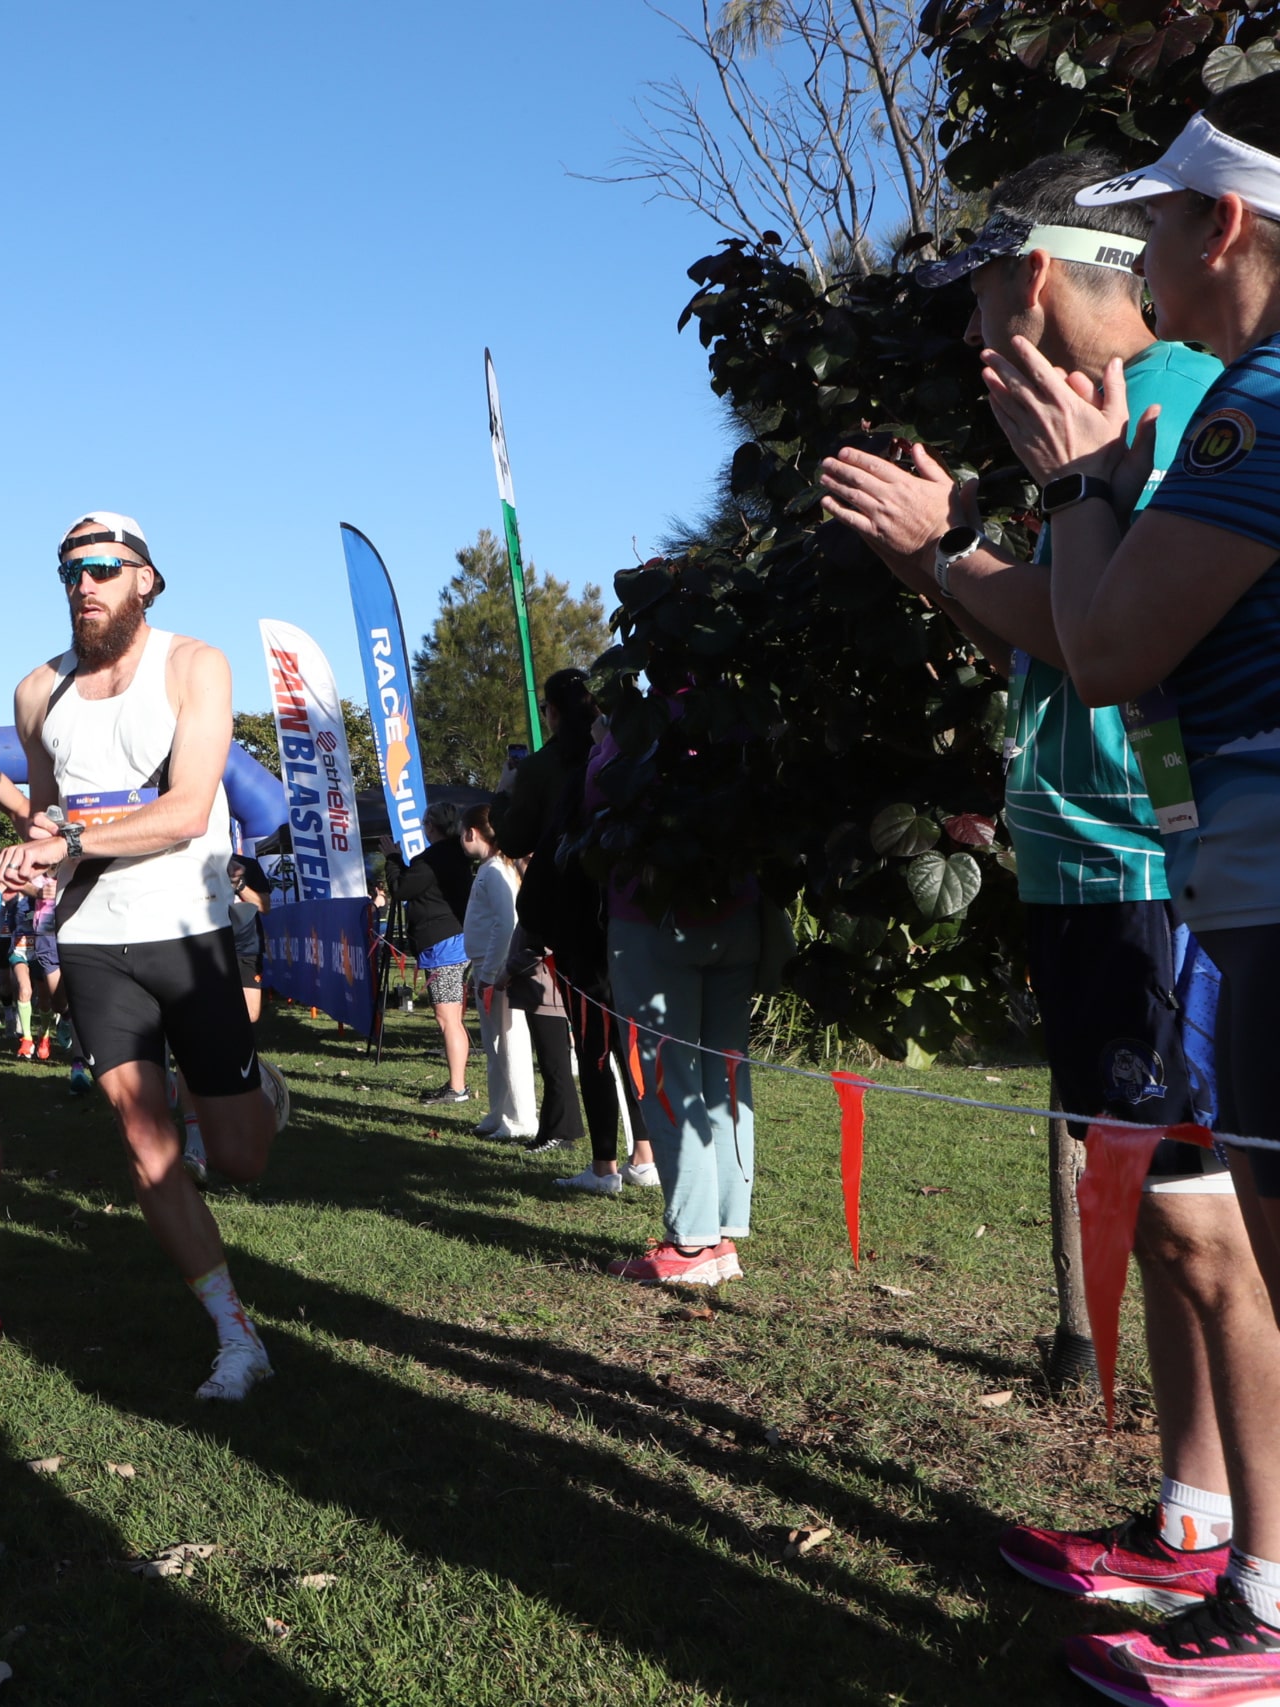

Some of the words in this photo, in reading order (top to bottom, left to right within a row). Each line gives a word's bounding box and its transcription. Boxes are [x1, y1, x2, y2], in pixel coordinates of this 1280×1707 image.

[1095, 246, 1139, 268] IRO
[270, 648, 310, 733] PAIN
[371, 628, 403, 745] RACE
[395, 770, 426, 860] HUB
[1162, 751, 1183, 769] 10k
[282, 735, 332, 900] BLASTER
[322, 753, 350, 852] athelite
